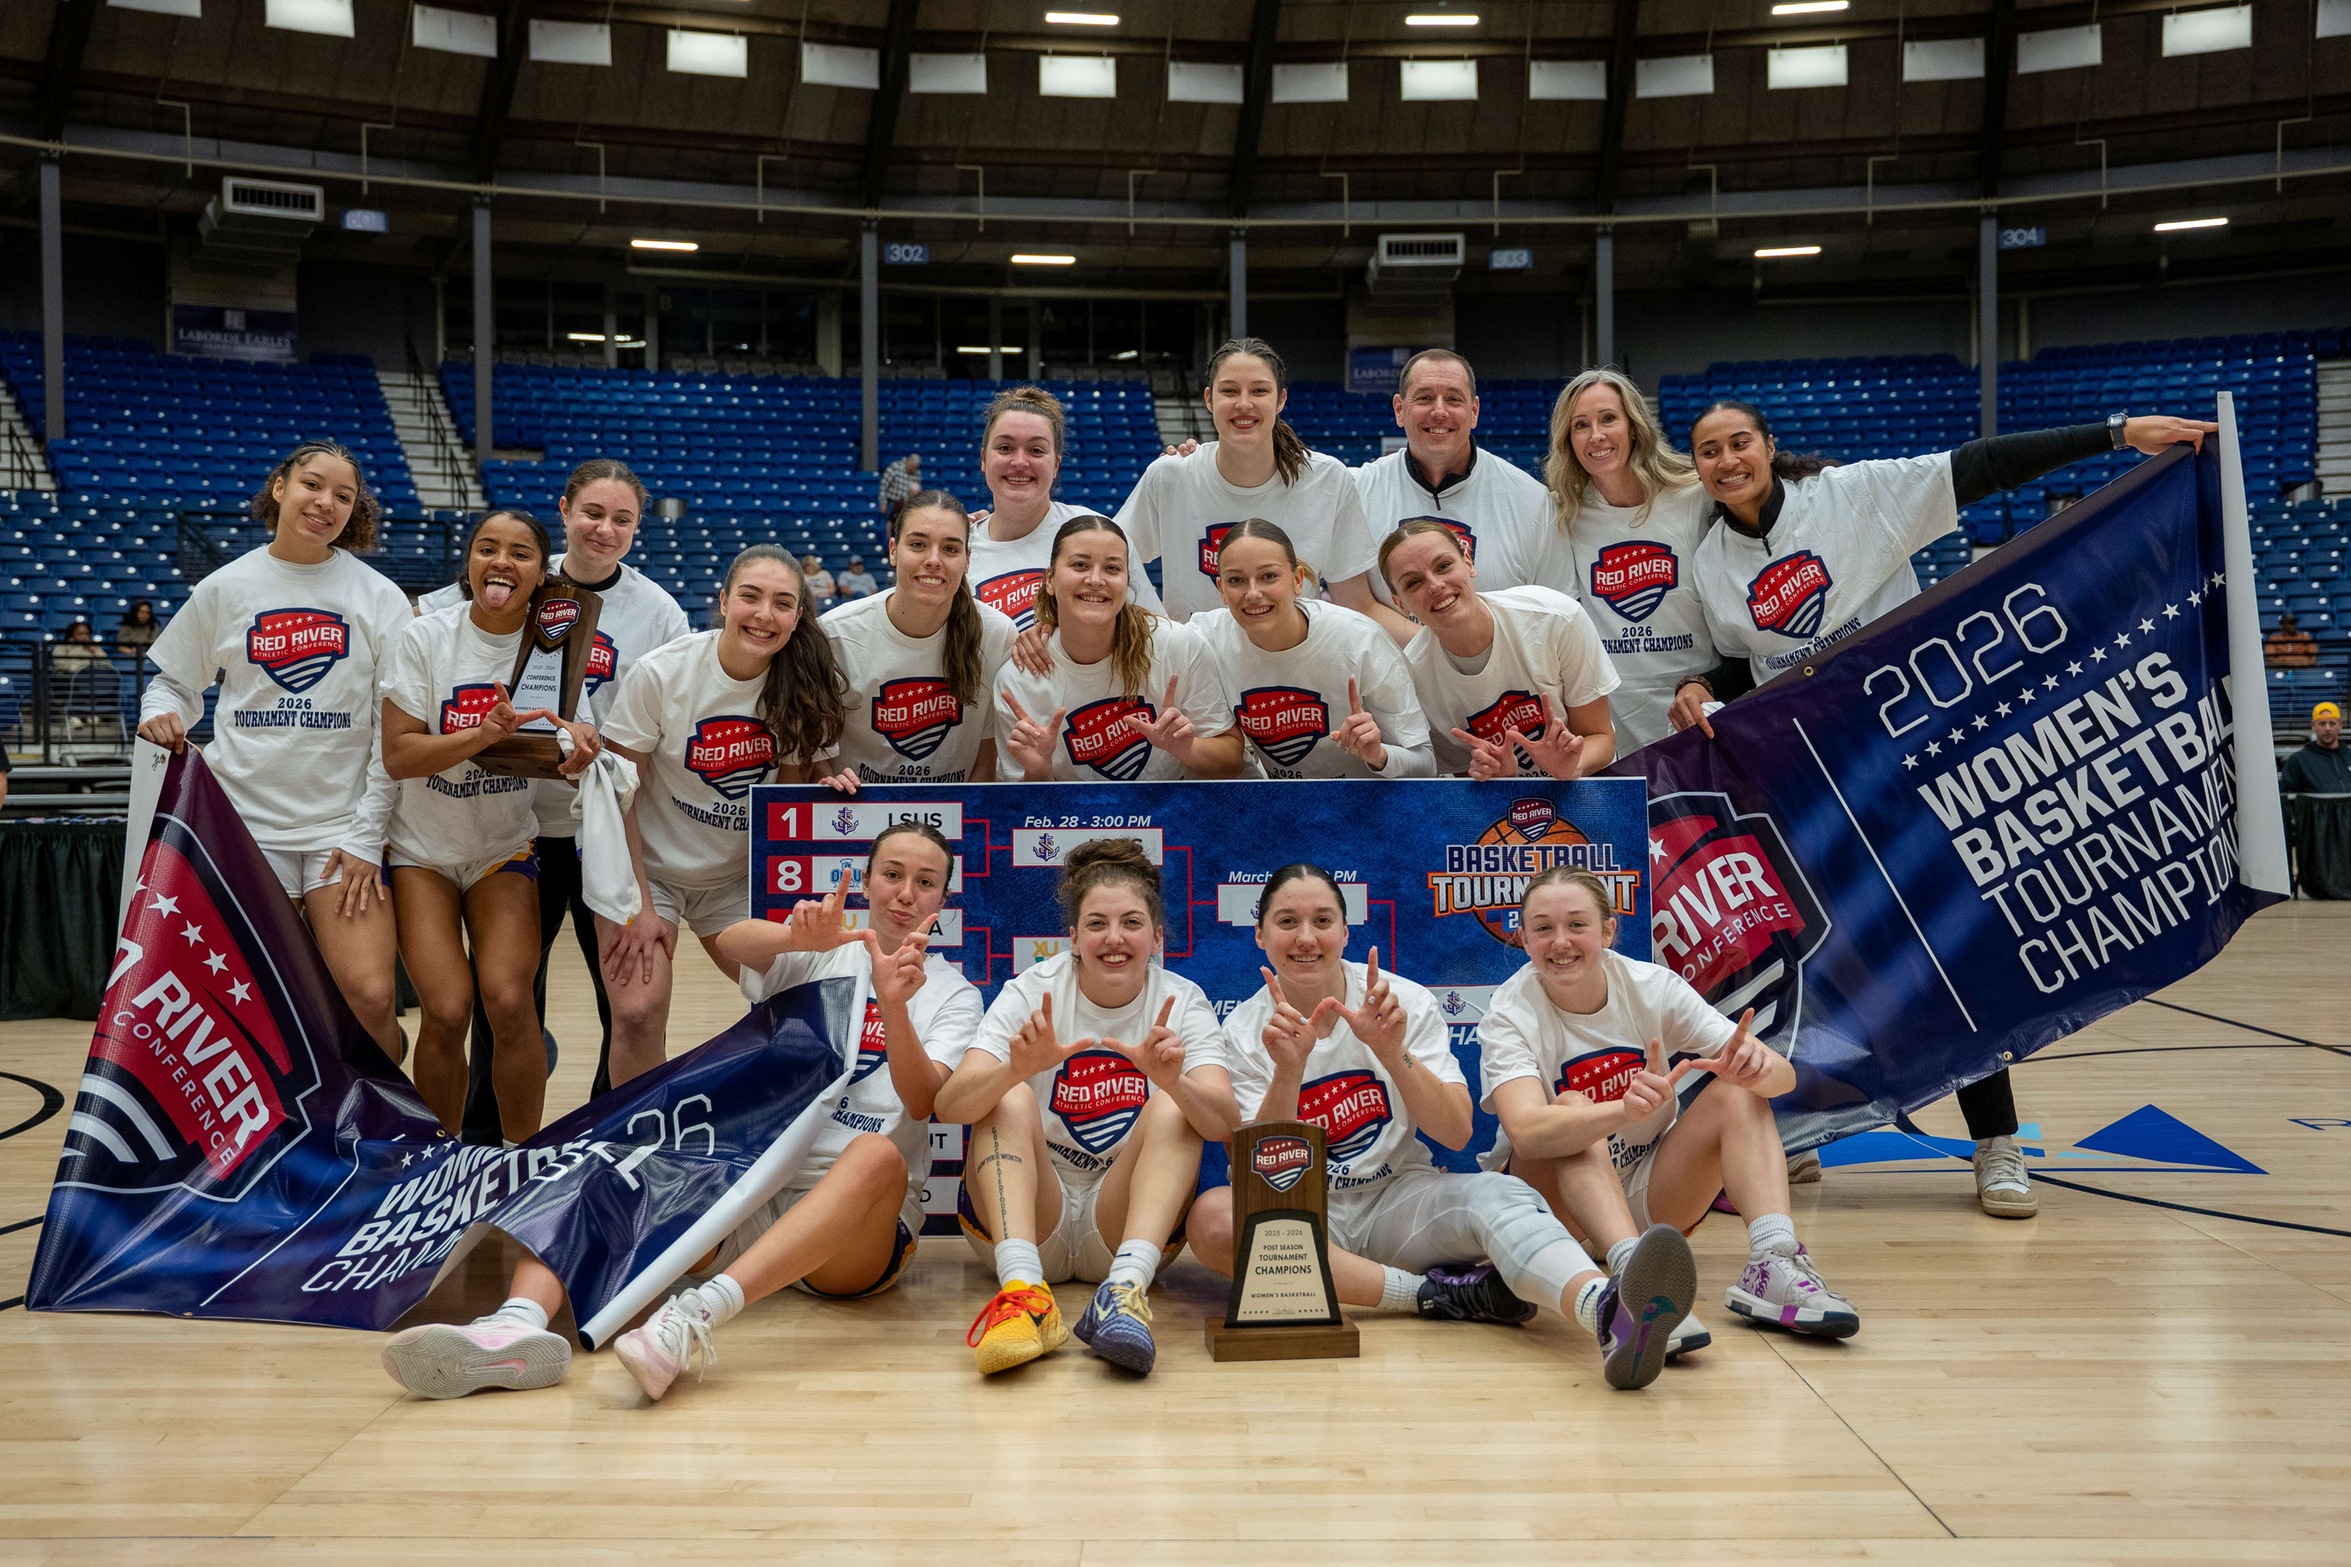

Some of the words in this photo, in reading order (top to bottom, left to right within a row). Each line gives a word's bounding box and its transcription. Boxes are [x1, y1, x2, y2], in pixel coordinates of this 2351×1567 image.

[2003, 227, 2037, 246] 304
[889, 243, 923, 261] 302
[1596, 569, 1625, 586] RED
[1628, 559, 1672, 580] RIVER
[1597, 584, 1627, 592] ATHLETIC
[1629, 573, 1672, 586] CONFERENCE
[1006, 582, 1043, 606] RIVE
[1752, 594, 1780, 619] RED
[1779, 563, 1822, 600] RIVER
[1758, 606, 1785, 625] ATHLETIC
[1785, 576, 1825, 607] CONFERENCE
[540, 611, 554, 620] RED
[555, 608, 577, 618] RIVER
[253, 635, 286, 651] RED
[291, 626, 343, 647] RIVER
[1621, 626, 1653, 638] 2026
[1643, 633, 1694, 653] CHAMPIONS
[254, 649, 289, 658] ATHLETIC
[291, 641, 343, 653] CONFERENCE
[1863, 583, 2068, 739] 2026
[521, 683, 557, 692] CHAMPIONS
[526, 674, 556, 682] CONFERENCE
[277, 697, 312, 709] 2026
[877, 706, 908, 722] RED
[912, 694, 957, 718] RIVER
[234, 710, 297, 728] TOURNAMENT
[300, 710, 351, 729] CHAMPIONS
[446, 710, 481, 728] RED
[878, 721, 910, 729] ATHLETIC
[912, 711, 957, 725] CONFERENCE
[1240, 714, 1271, 731] RED
[1276, 707, 1323, 727] RIVER
[1276, 721, 1323, 733] CONFERENCE
[1501, 703, 1540, 732] RIVER
[692, 745, 726, 762] RED
[729, 737, 772, 759] RIVER
[1071, 732, 1104, 752] RED
[1077, 746, 1109, 758] ATHLETIC
[1109, 727, 1140, 747] CONFERE
[1917, 651, 2188, 832] WOMEN'S
[729, 753, 773, 764] CONFERENCE
[899, 764, 931, 776] 2026
[1273, 767, 1303, 779] 2026
[426, 774, 480, 798] TOURNAMENT
[482, 776, 529, 794] CHAMPIONS
[712, 802, 746, 816] 2026
[1512, 812, 1528, 821] RED
[1529, 808, 1552, 818] RIVER
[781, 807, 797, 838] 1
[1024, 816, 1055, 828] Feb.
[1059, 816, 1079, 828] 28
[1090, 816, 1124, 828] 3:00
[1127, 815, 1151, 827] PM
[1981, 743, 2238, 938] TOURNAMEN
[1446, 843, 1621, 874] BASKETBALL
[777, 860, 802, 892] 8
[1228, 871, 1273, 883] March
[1333, 870, 1357, 882] PM
[1431, 875, 1637, 913] TOURNNT
[2018, 815, 2240, 994] CHAMPION
[1652, 852, 1778, 969] RIVER
[1681, 902, 1792, 983] ONFERENCE
[131, 970, 270, 1149] RIVER
[113, 1010, 236, 1166] CONFERENCE
[1057, 1082, 1091, 1103] RED
[1094, 1076, 1145, 1100] RIVER
[1055, 1100, 1093, 1110] ATHLETIC
[1095, 1095, 1145, 1107] CONFERENCE
[1332, 1088, 1384, 1123] RIVER
[831, 1109, 885, 1133] HAMPIONS
[1336, 1106, 1386, 1131] CONFERENCE
[1256, 1154, 1276, 1165] RED
[1279, 1149, 1308, 1162] RIVER
[1259, 1253, 1307, 1261] TOURNAMENT
[1255, 1265, 1312, 1275] CHAMPIONS
